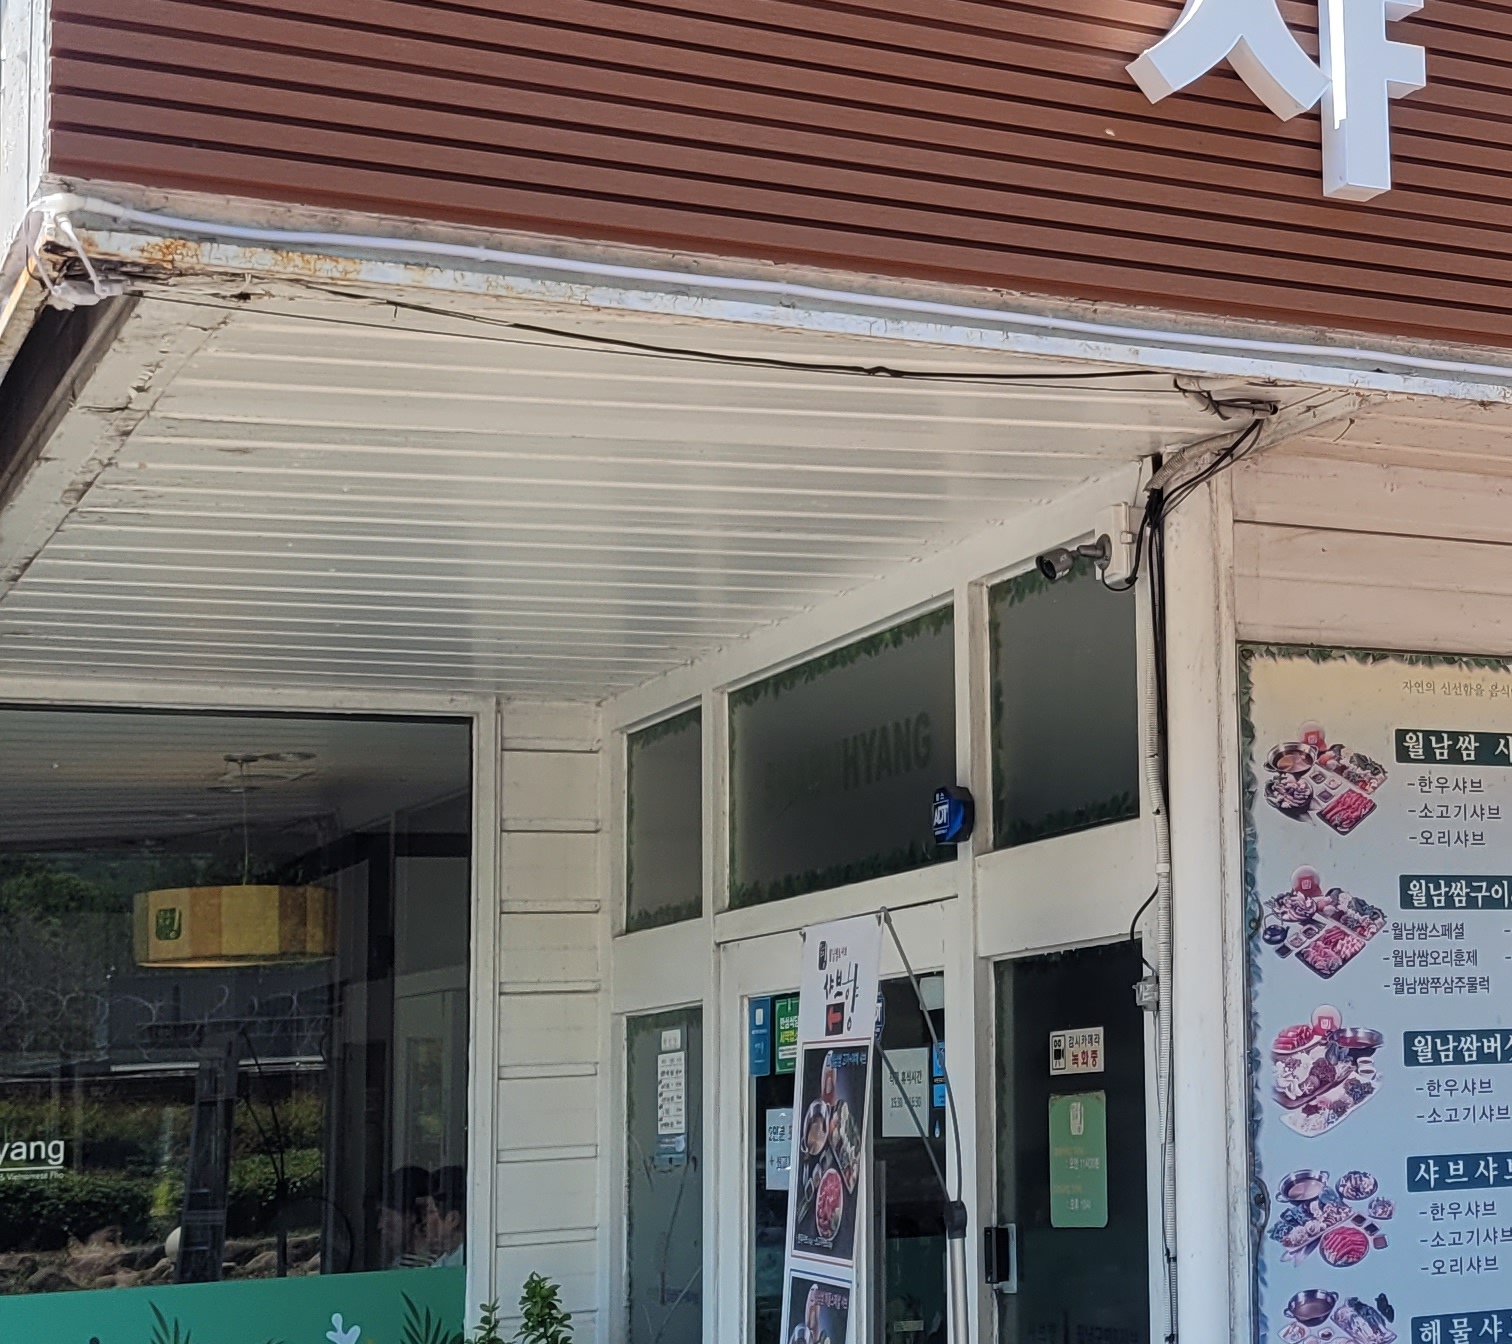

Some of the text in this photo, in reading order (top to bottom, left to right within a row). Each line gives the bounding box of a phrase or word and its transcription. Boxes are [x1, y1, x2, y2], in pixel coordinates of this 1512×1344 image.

[842, 712, 931, 790] HYANG
[1402, 732, 1480, 762] 월남쌈
[1068, 1033, 1101, 1049] 감시카메라
[1072, 1049, 1099, 1068] 녹화중
